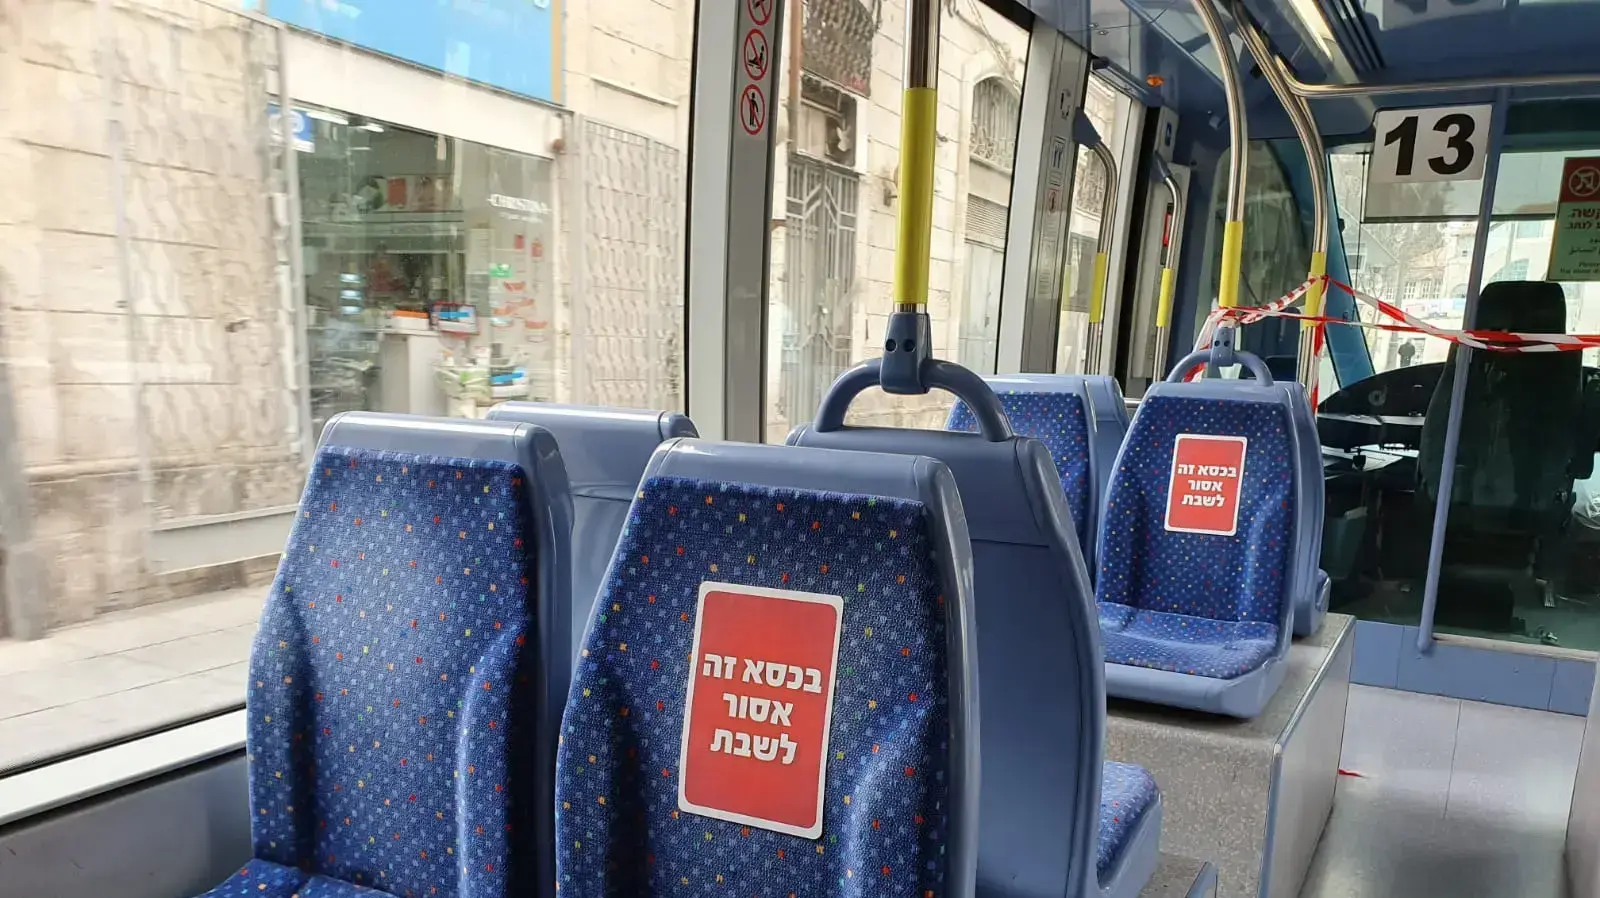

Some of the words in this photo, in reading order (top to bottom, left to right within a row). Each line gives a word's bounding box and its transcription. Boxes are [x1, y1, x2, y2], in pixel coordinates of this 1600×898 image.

[1384, 113, 1475, 175] 13
[1177, 464, 1195, 475] זה
[1198, 464, 1237, 477] בכסא
[1188, 479, 1223, 492] אסור
[1181, 494, 1225, 507] לשבת
[702, 653, 737, 680] זה
[742, 658, 822, 694] בכסא
[723, 692, 794, 727] אסור
[710, 728, 797, 765] לשבת
